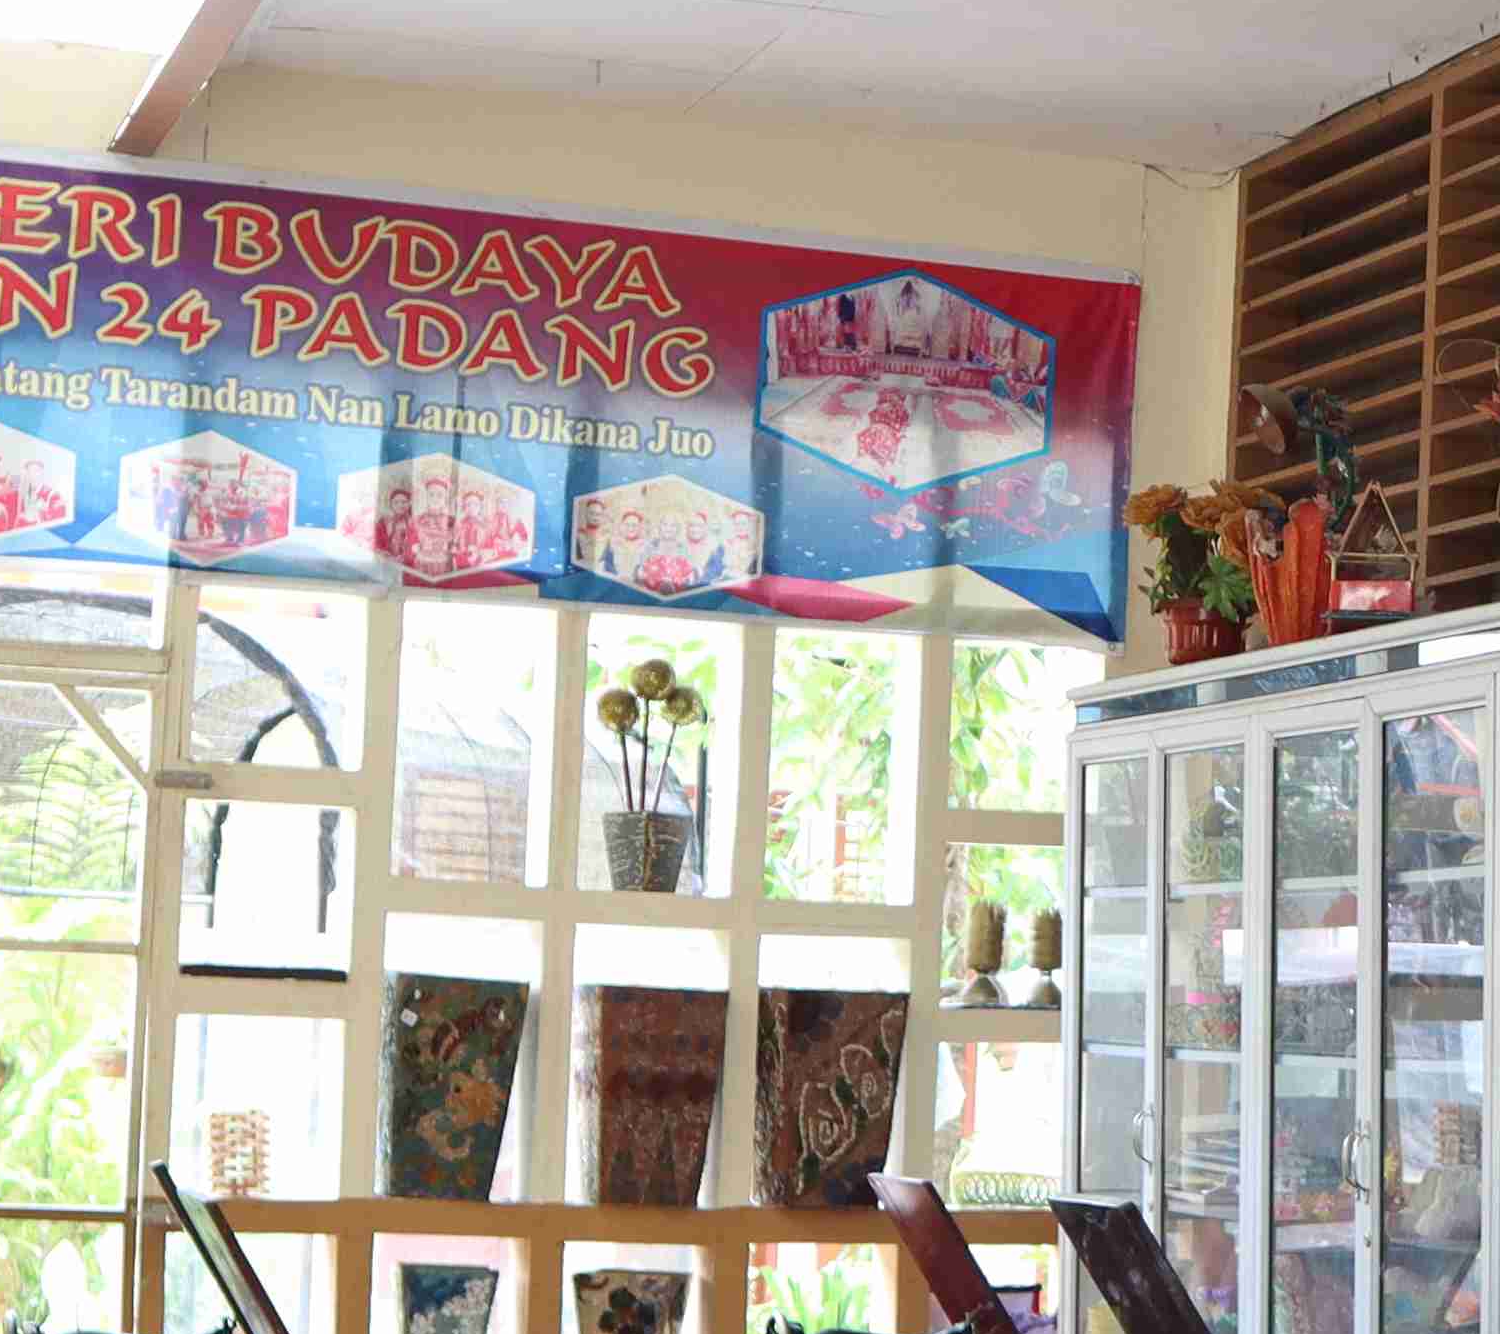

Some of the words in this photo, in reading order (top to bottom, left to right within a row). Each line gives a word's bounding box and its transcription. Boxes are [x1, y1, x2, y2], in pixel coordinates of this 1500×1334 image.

[204, 201, 681, 319] BUDAYA
[97, 280, 223, 353] 24
[243, 285, 715, 398] PADANG
[102, 366, 296, 419] Tarandam
[307, 385, 383, 428] Nan
[396, 394, 499, 437] Lamo
[509, 405, 639, 453] Dikana
[647, 420, 714, 458] Juo
